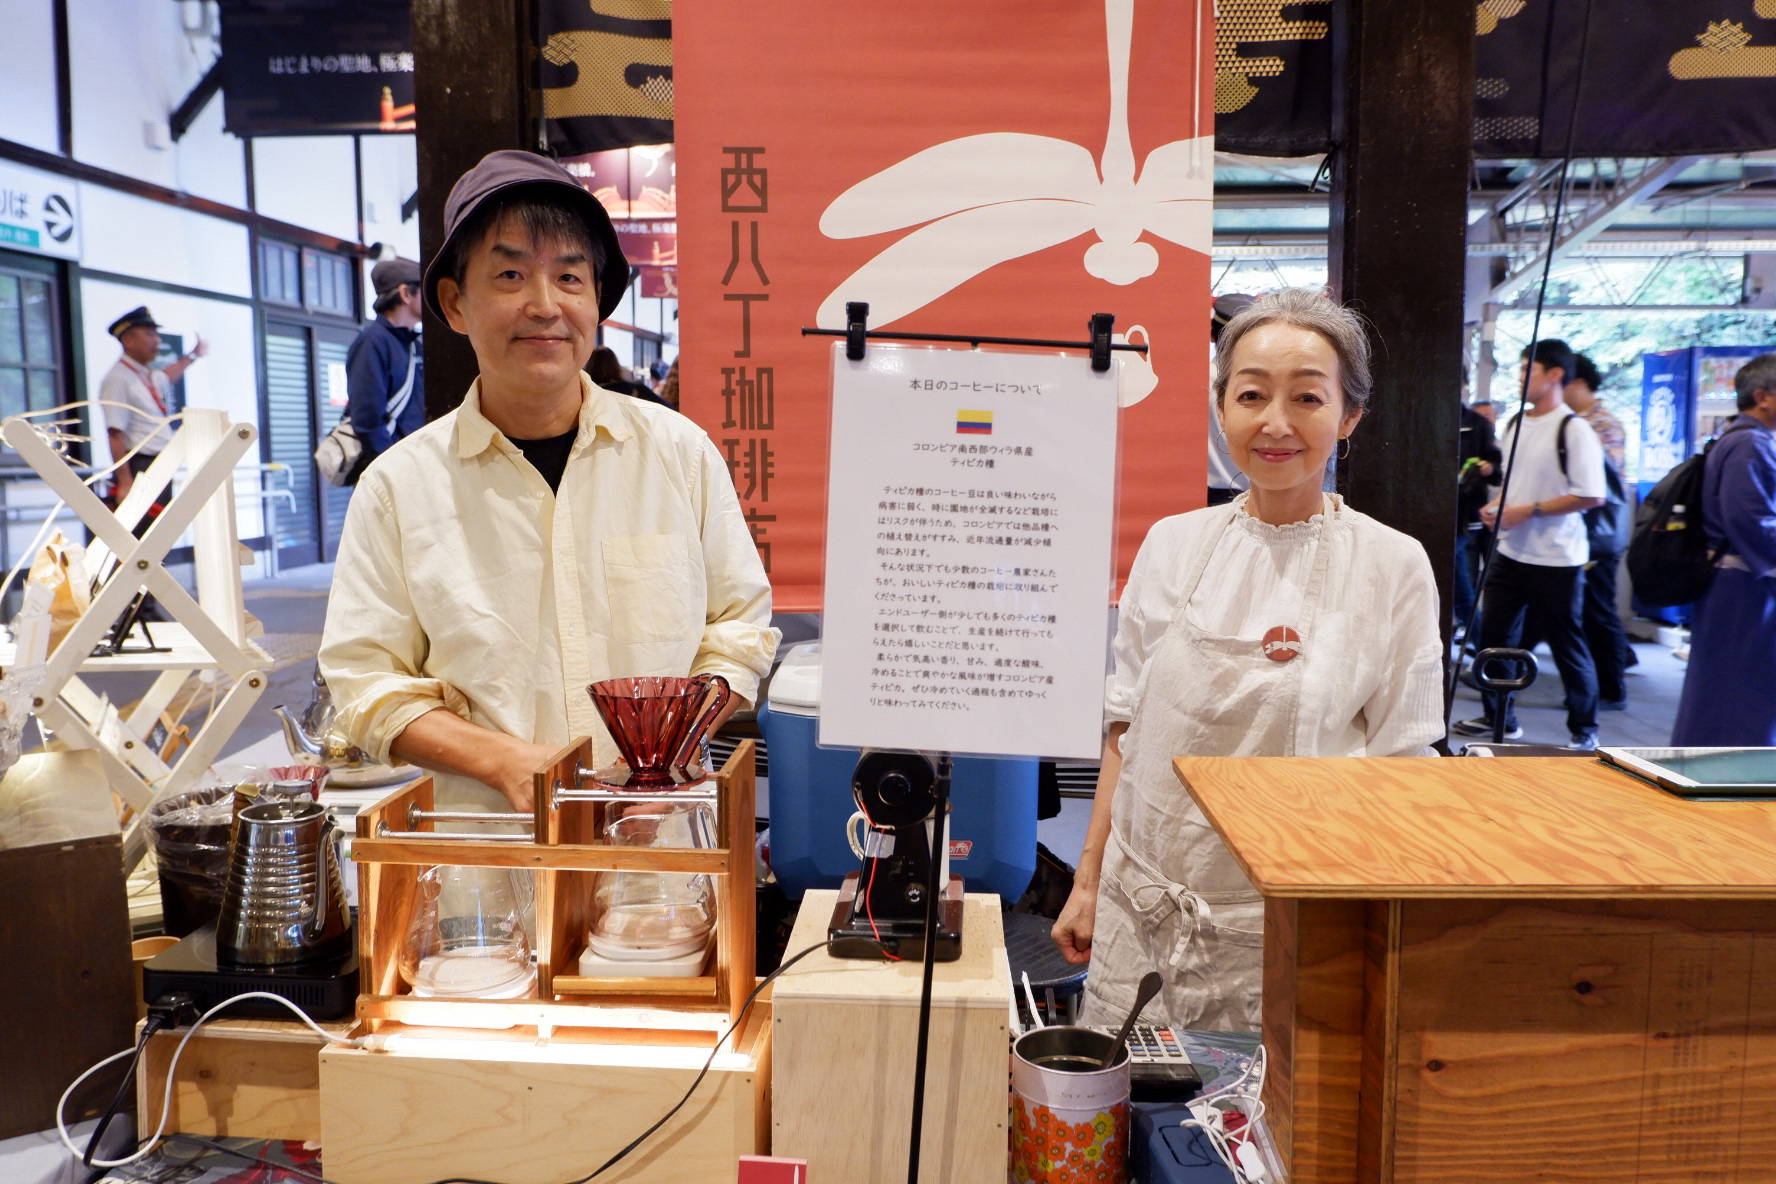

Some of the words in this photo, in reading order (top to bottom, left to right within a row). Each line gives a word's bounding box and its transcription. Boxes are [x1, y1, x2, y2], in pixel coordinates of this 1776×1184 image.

[909, 377, 1042, 395] 本日のコーヒーについて
[912, 442, 1034, 457] コロンビア南西部ウィラ県産
[949, 456, 996, 469] ティピカ種
[883, 484, 1057, 501] ティピカ種のコーヒー豆は良い味わいながら
[877, 500, 1059, 517] 病害に弱く、時に園地が全滅するなど栽培に
[876, 516, 1060, 532] はリスクが伴うため、コロンビアでは他品種へ
[875, 531, 1052, 548] の植え替えがすすみ、近年流通量が減少傾
[875, 546, 931, 558] 向にあります。
[879, 562, 1056, 578] そんな状況下でも少数のコーヒー農家さんた
[874, 576, 1059, 593] ちが、おいしいティピカ種の栽培に取り組んで
[873, 592, 942, 604] くださっています。
[877, 608, 1057, 624] エンドユーザー側が少しでも多くのティピカ種
[872, 622, 1054, 639] を選択して飲むことで、生産を続けて行っても
[871, 637, 1000, 652] らえたら嬉しいことだと思います。
[870, 667, 1055, 685] 冷めることで爽やかな風味が増すコロンビア産
[868, 697, 970, 711] りと味わってみてください。
